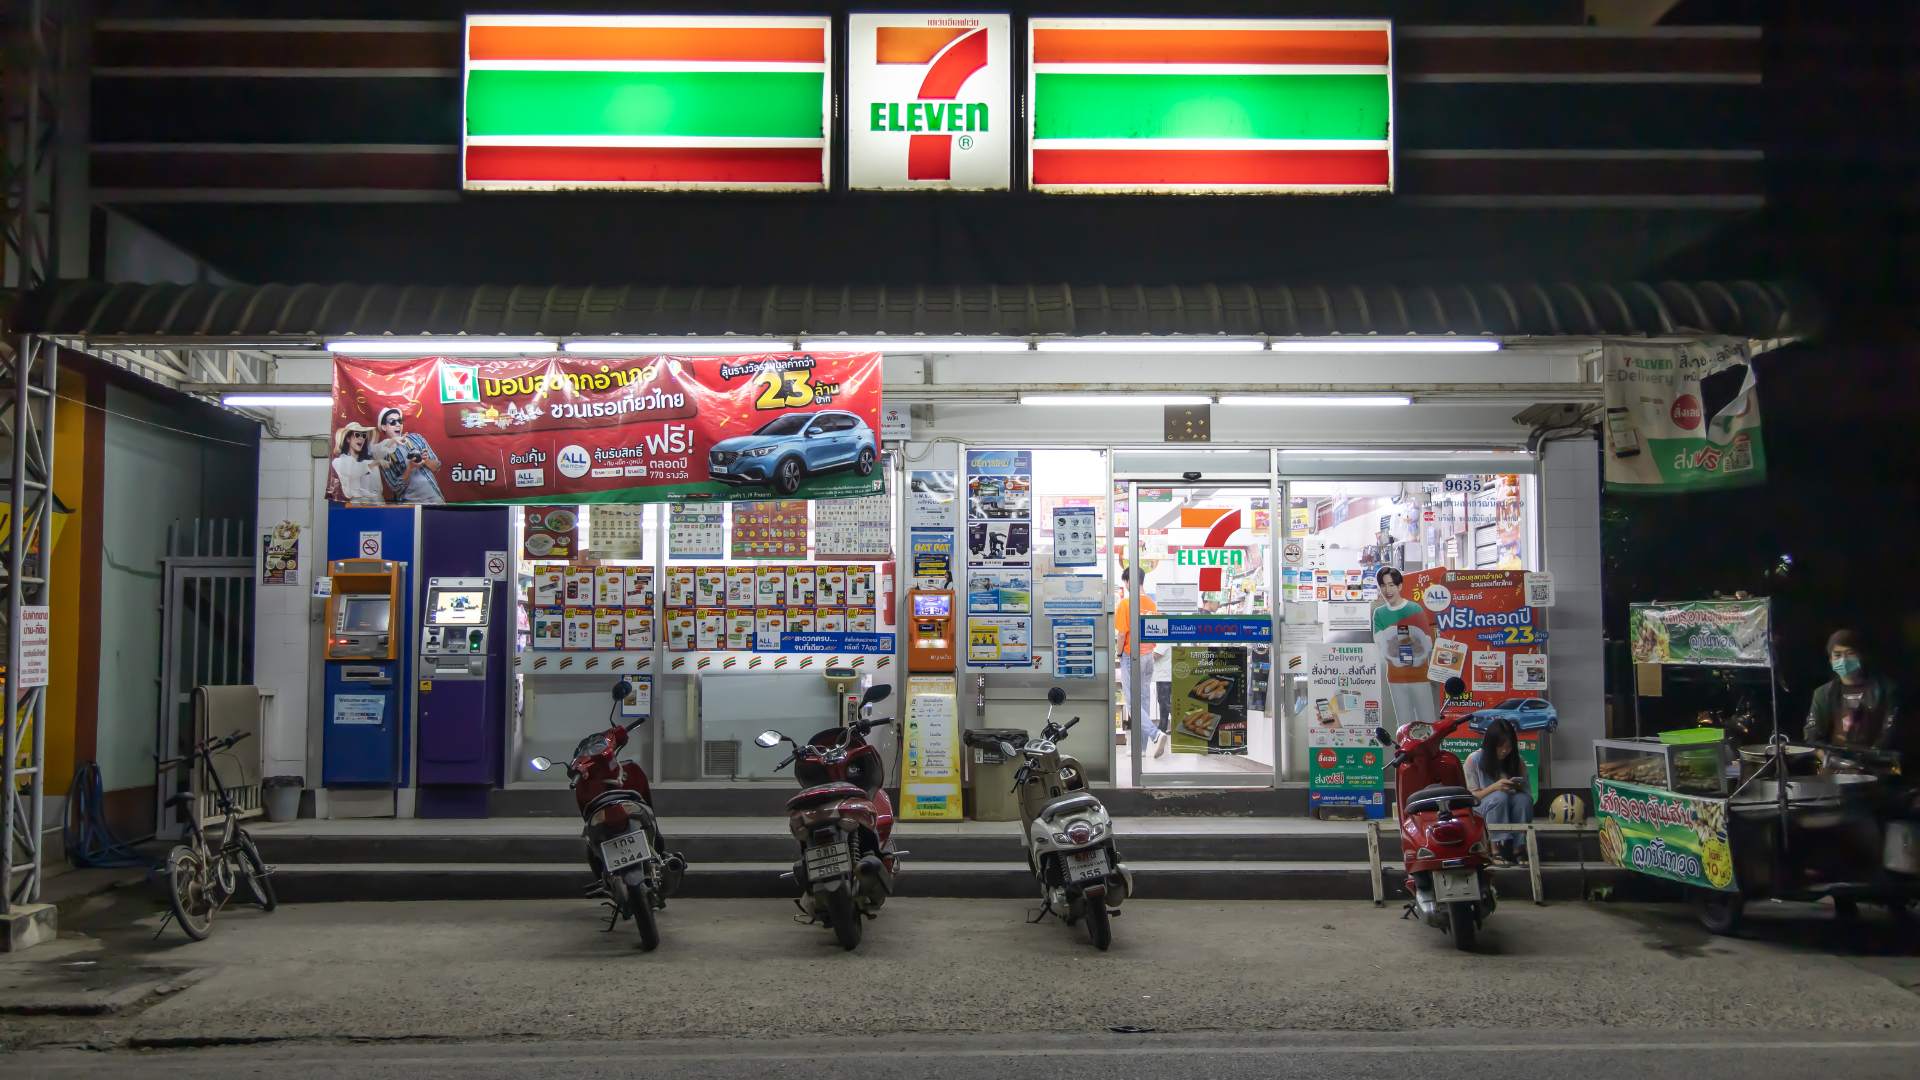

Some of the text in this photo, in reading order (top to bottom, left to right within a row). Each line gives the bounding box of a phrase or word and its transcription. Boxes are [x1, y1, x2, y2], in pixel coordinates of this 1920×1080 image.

[877, 27, 988, 181] 7
[1617, 370, 1674, 385] Delivery
[754, 370, 814, 410] 23
[815, 382, 840, 396] ล้าน
[550, 388, 685, 419] ชวนเธอเที่ยวไทย
[645, 423, 694, 456] ฟรี!
[560, 452, 587, 464] ALL
[650, 457, 688, 469] ตลอดปี
[518, 472, 534, 480] ALL
[650, 470, 664, 479] 770
[1445, 480, 1481, 491] 9635
[1180, 508, 1241, 591] 7
[1426, 590, 1448, 600] ALL
[1437, 606, 1531, 629] ฟรี! ตลอดปี
[1504, 626, 1535, 643] 23
[1328, 654, 1363, 662] Delivery
[613, 851, 643, 867] 3944
[1633, 838, 1700, 878] ลูกชิ้นทอด
[1707, 862, 1719, 877] 10
